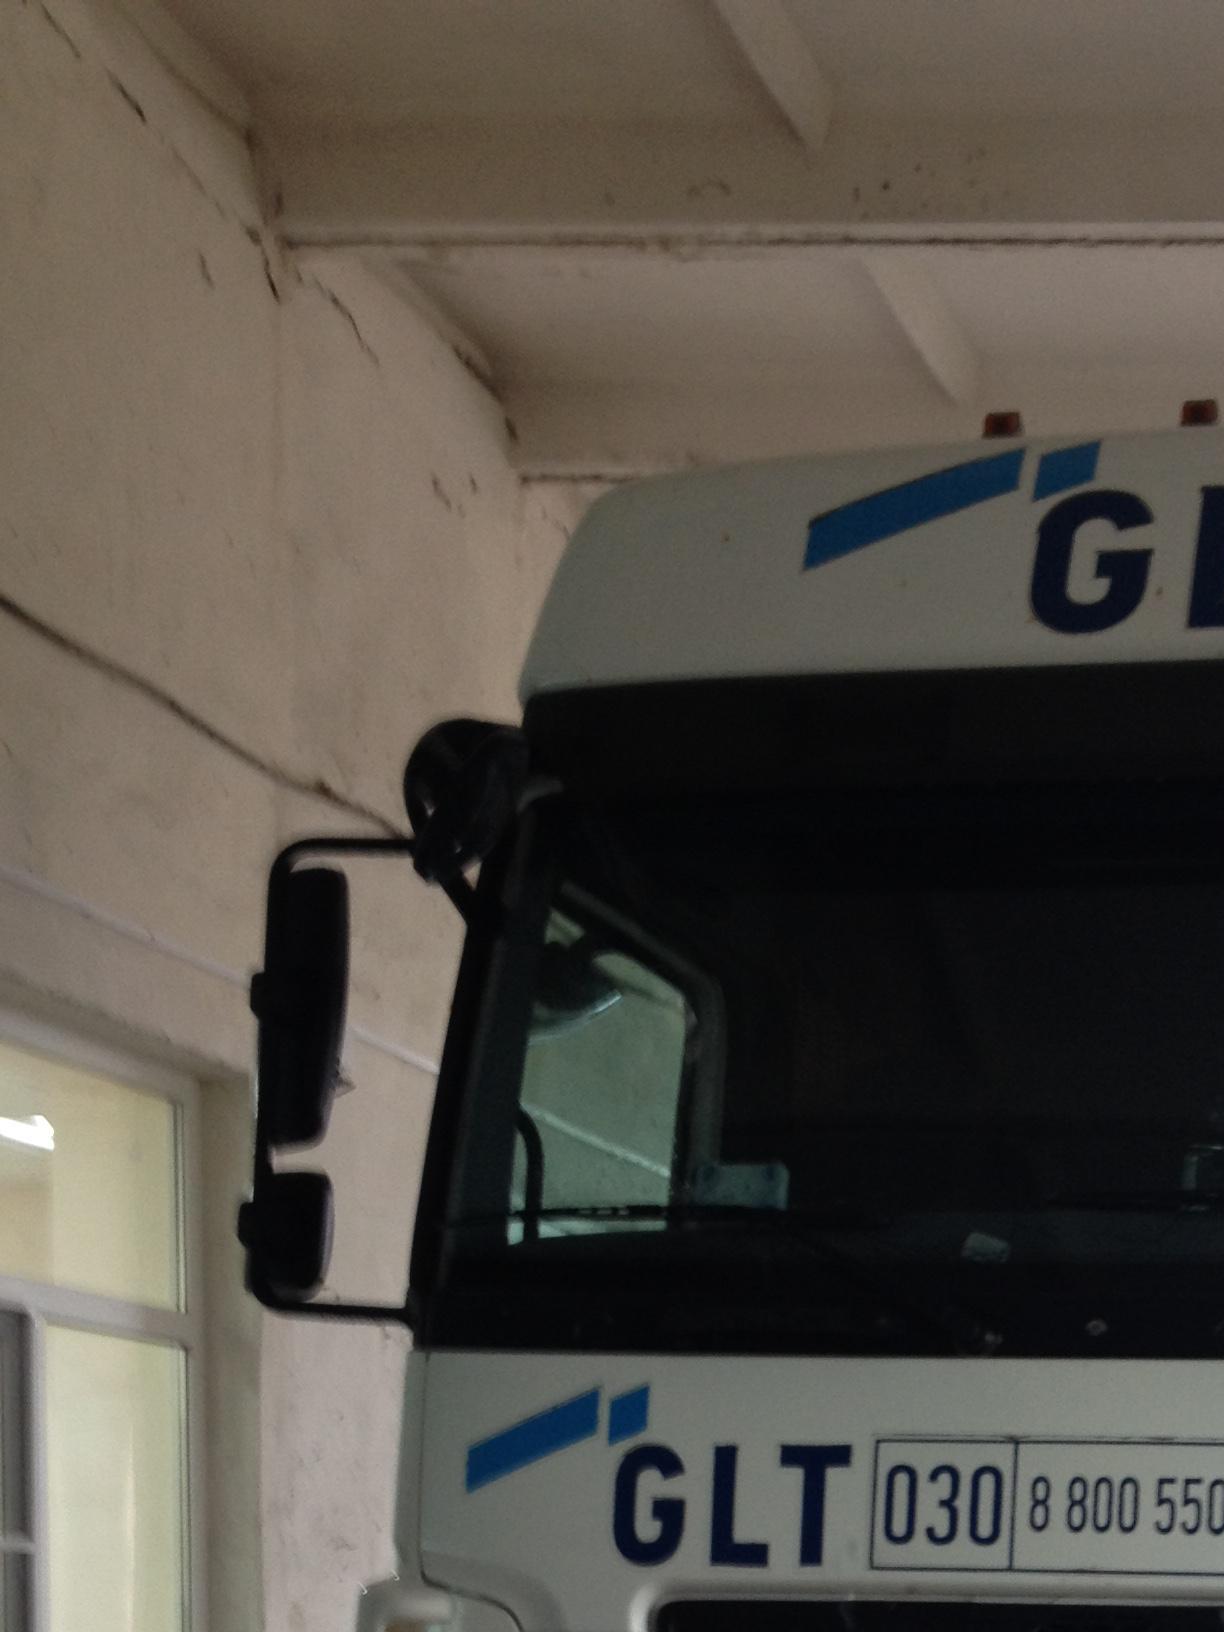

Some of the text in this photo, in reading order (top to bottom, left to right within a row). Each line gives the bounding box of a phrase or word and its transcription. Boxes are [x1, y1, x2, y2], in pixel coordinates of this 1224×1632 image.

[613, 1444, 852, 1567] GLT
[884, 1464, 1003, 1546] 030
[1029, 1476, 1051, 1532] 8
[1066, 1477, 1139, 1534] 800
